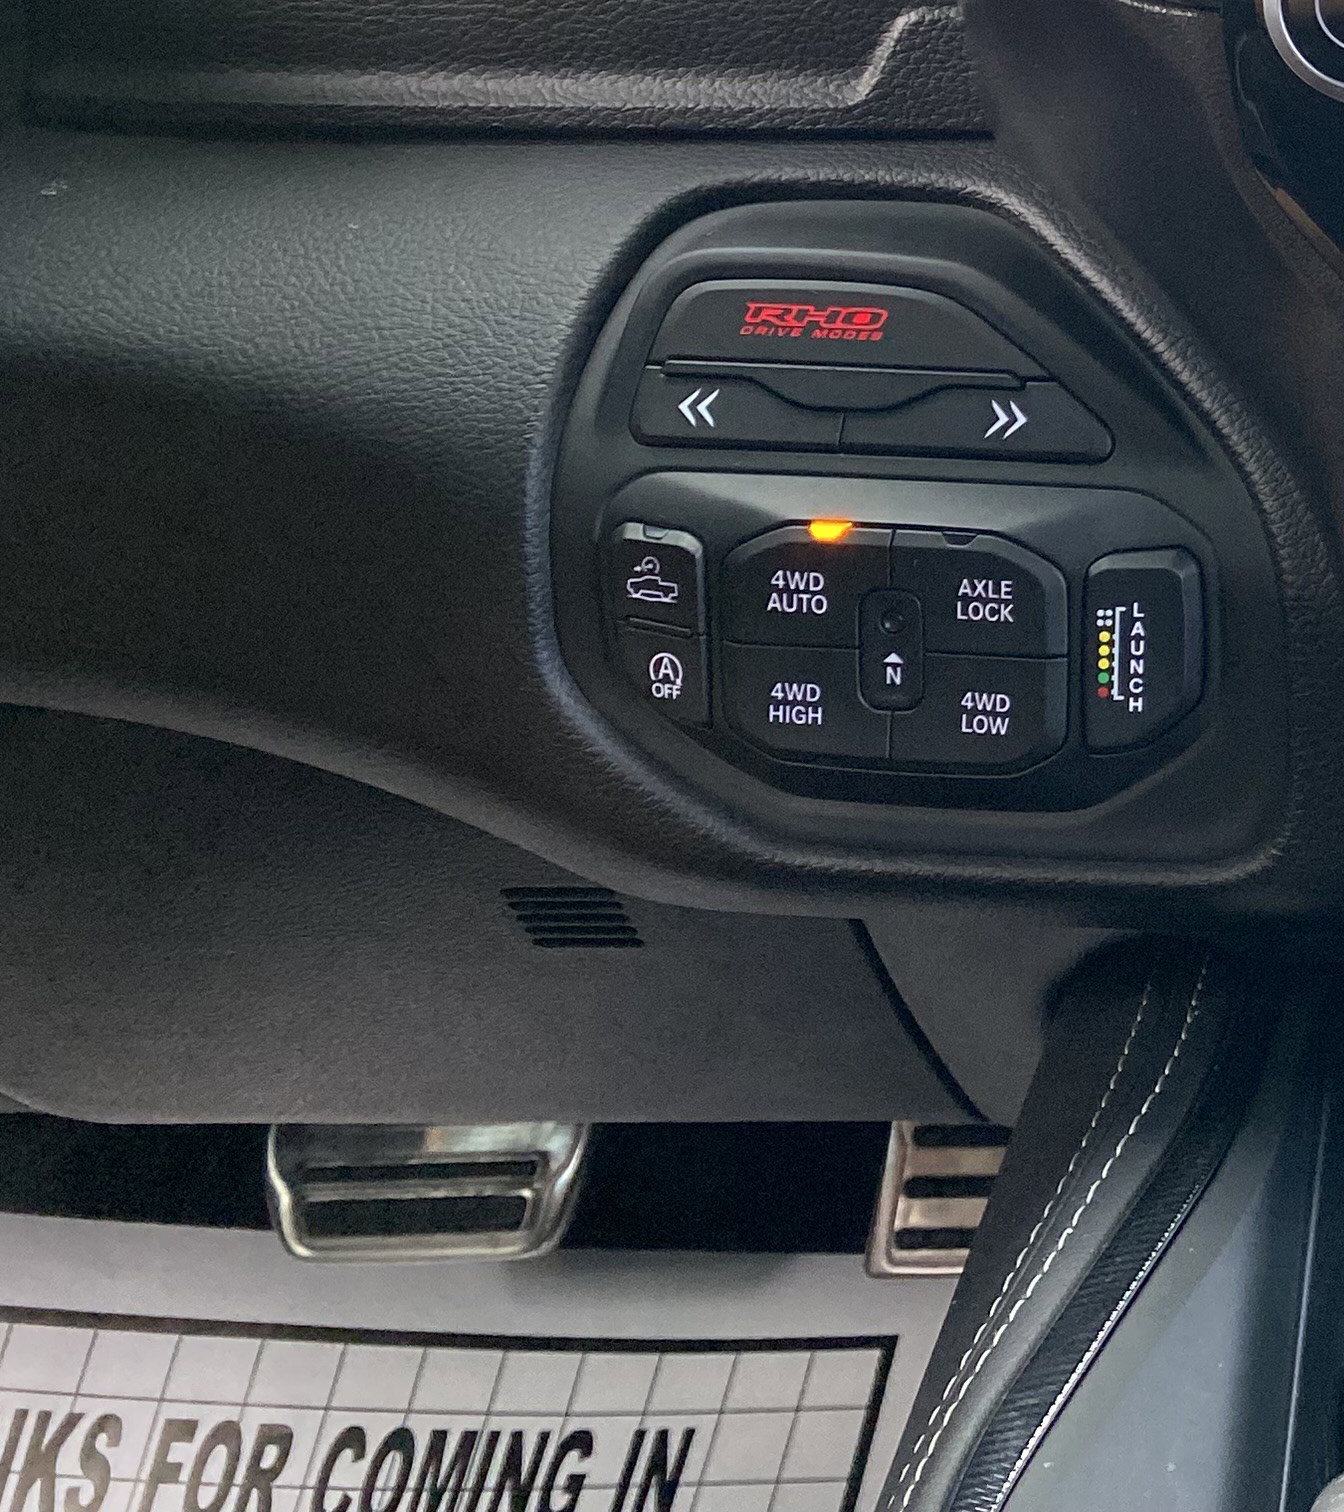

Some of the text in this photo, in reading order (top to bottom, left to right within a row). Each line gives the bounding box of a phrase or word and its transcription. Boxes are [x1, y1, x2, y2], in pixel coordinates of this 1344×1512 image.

[744, 301, 889, 330] RHO
[770, 570, 825, 591] 4WD
[956, 578, 1014, 598] AXLE
[766, 594, 828, 615] AUTO
[956, 602, 1015, 623] LOCK
[886, 661, 903, 685] N
[651, 682, 682, 700] OFF
[770, 682, 822, 703] 4WD
[961, 692, 1011, 713] 4WD
[768, 704, 823, 725] HIGH
[960, 714, 1010, 735] LOW
[138, 1418, 294, 1512] FOR
[310, 1425, 593, 1512] COMING
[609, 1427, 697, 1512] IN
